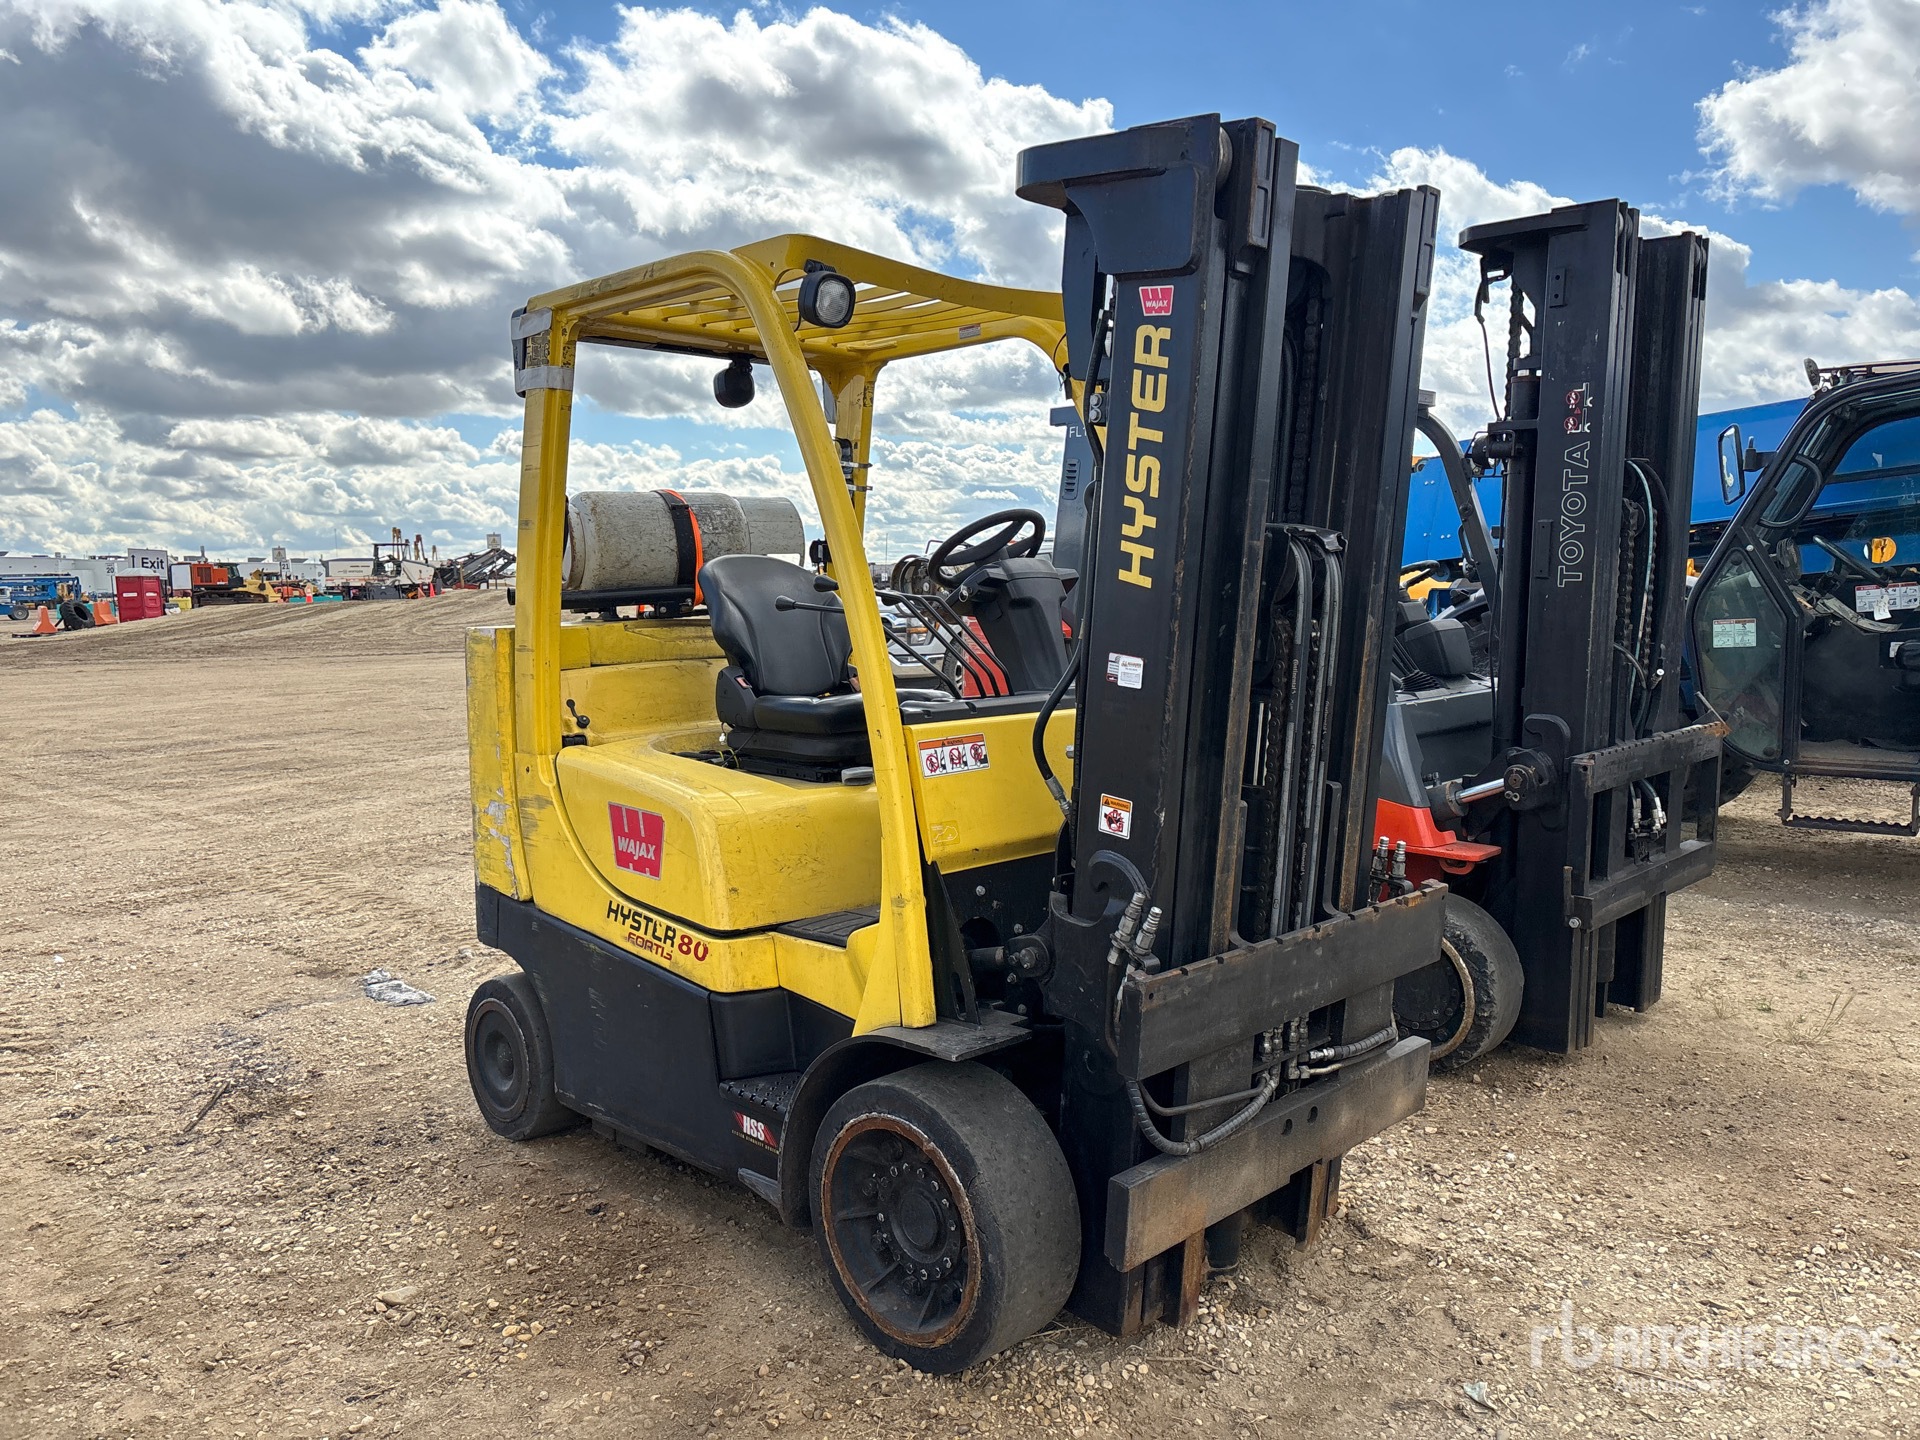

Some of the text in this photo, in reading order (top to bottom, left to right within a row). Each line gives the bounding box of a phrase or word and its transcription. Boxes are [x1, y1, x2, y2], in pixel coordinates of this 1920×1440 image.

[1145, 300, 1168, 309] WAJAX
[1117, 323, 1172, 589] HYSTER
[1557, 440, 1591, 588] TOYOTA
[141, 557, 165, 570] Exit
[617, 835, 656, 861] WAJAX
[677, 934, 709, 962] 80
[743, 1114, 765, 1141] HSS
